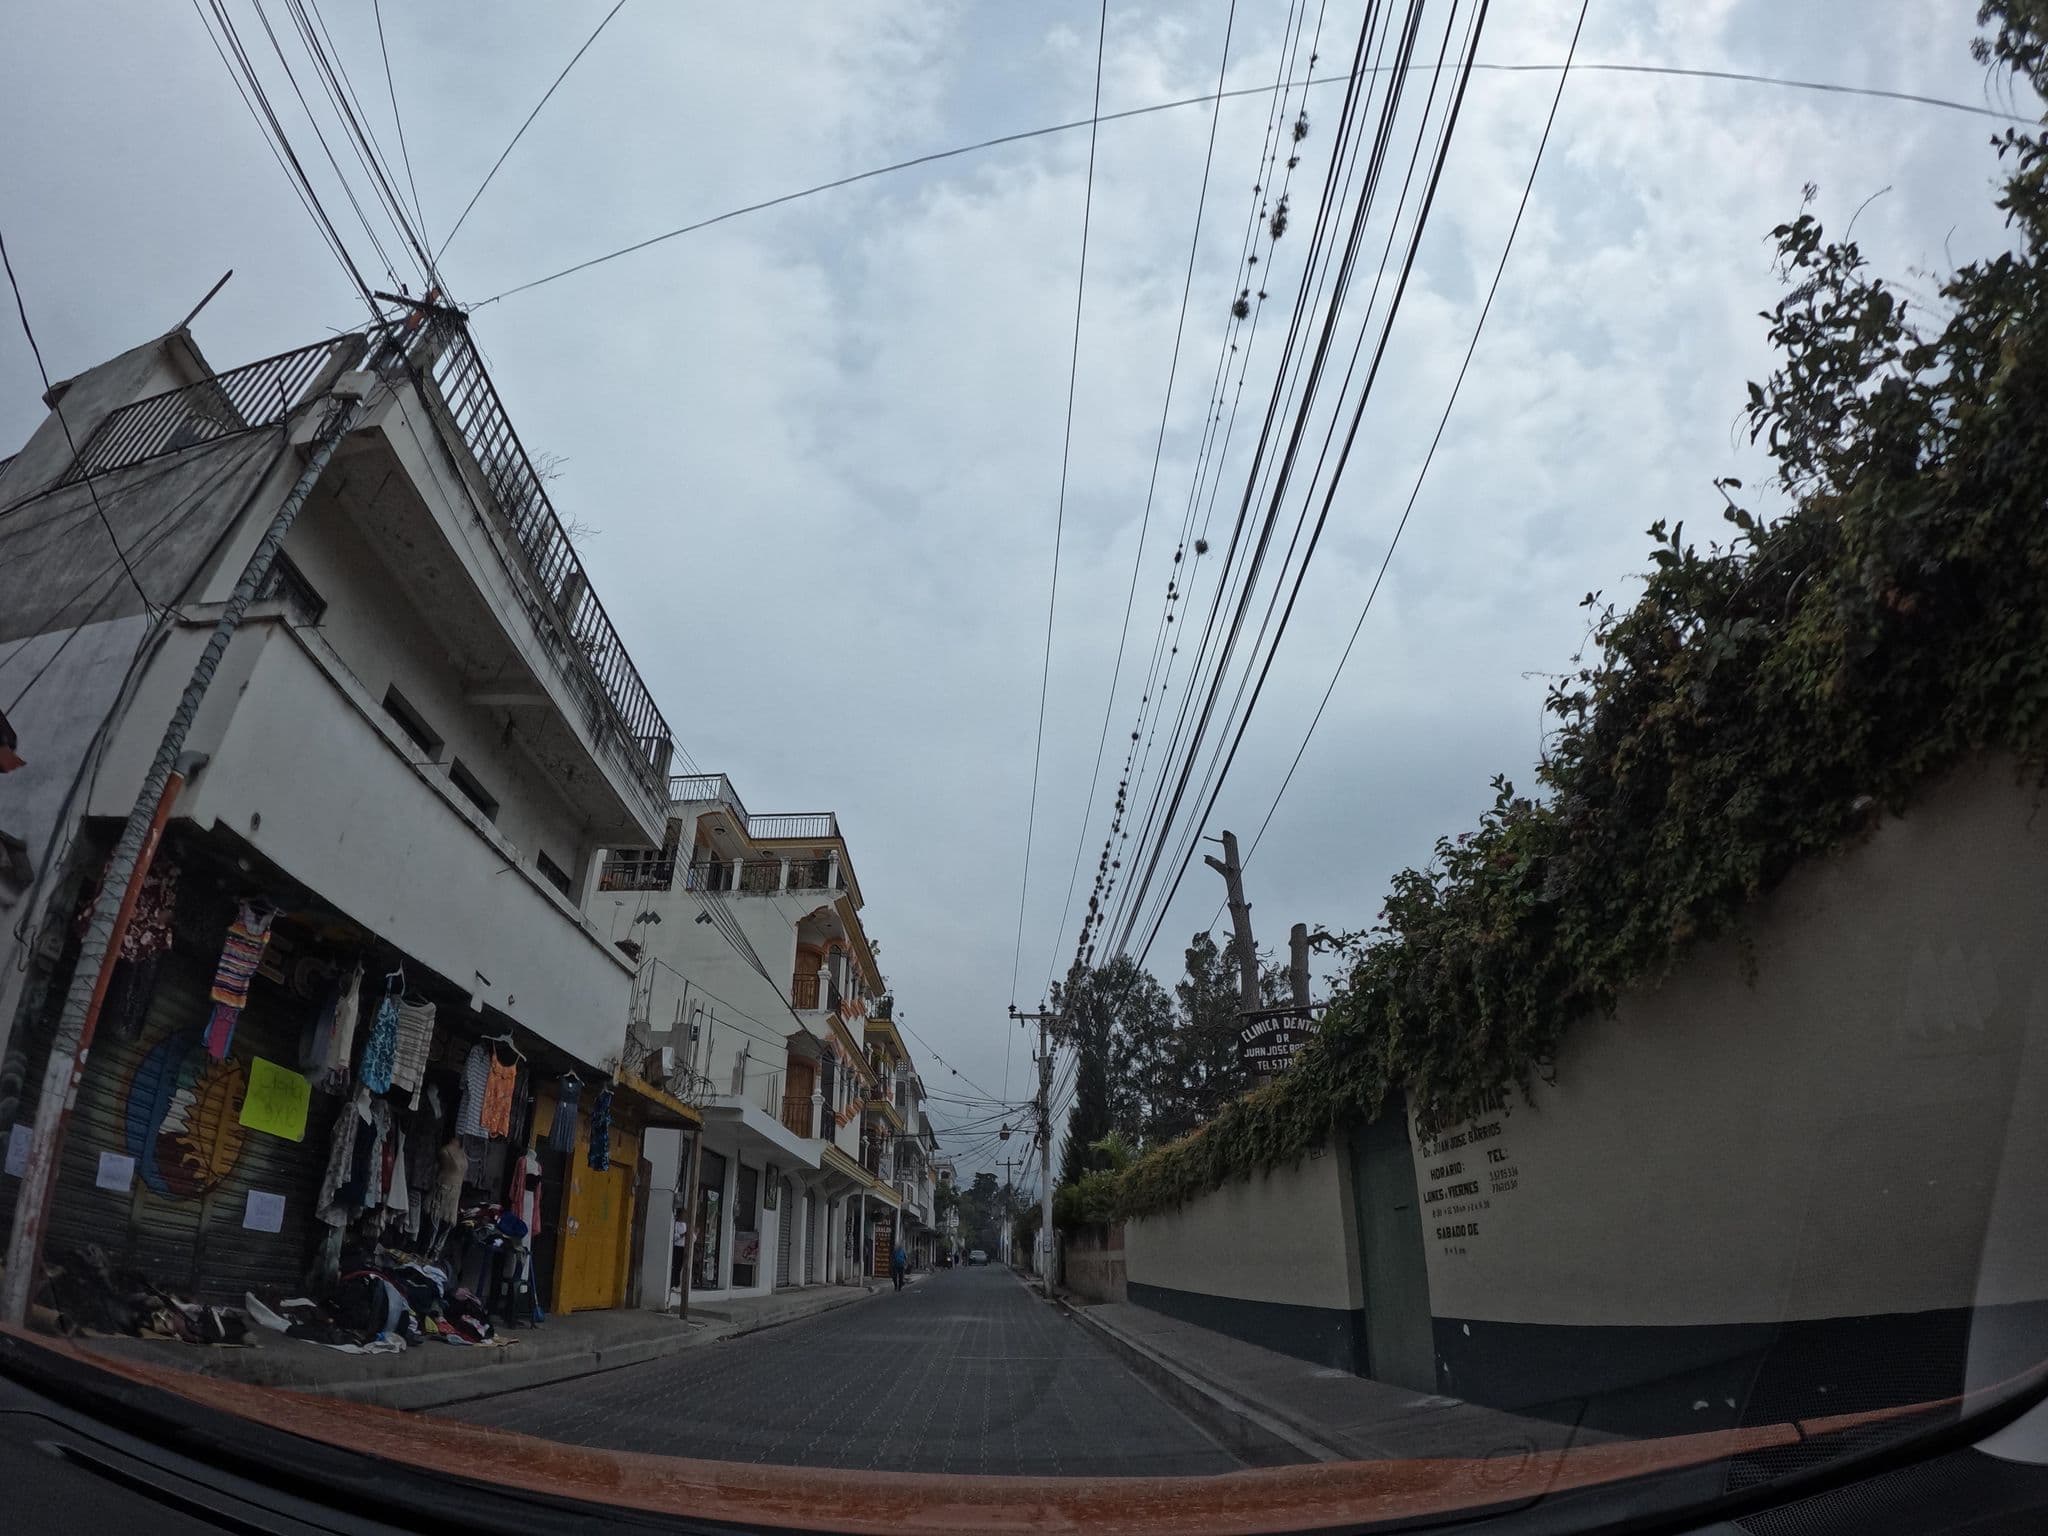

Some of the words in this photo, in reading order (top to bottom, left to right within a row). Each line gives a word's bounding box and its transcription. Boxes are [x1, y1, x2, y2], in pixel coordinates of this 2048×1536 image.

[1241, 1018, 1280, 1043] CLINICA
[1244, 1047, 1266, 1058] JUAN
[1266, 1045, 1289, 1056] JOSE
[1433, 1138, 1450, 1155] JUAN
[1450, 1133, 1467, 1150] JOSE
[1468, 1122, 1502, 1143] BARRIOS
[1430, 1161, 1465, 1181] HORARIO:
[1423, 1189, 1444, 1203] LUNES
[1448, 1181, 1479, 1199] VIERNES
[1436, 1225, 1466, 1240] SABADO
[1467, 1223, 1479, 1236] DE
